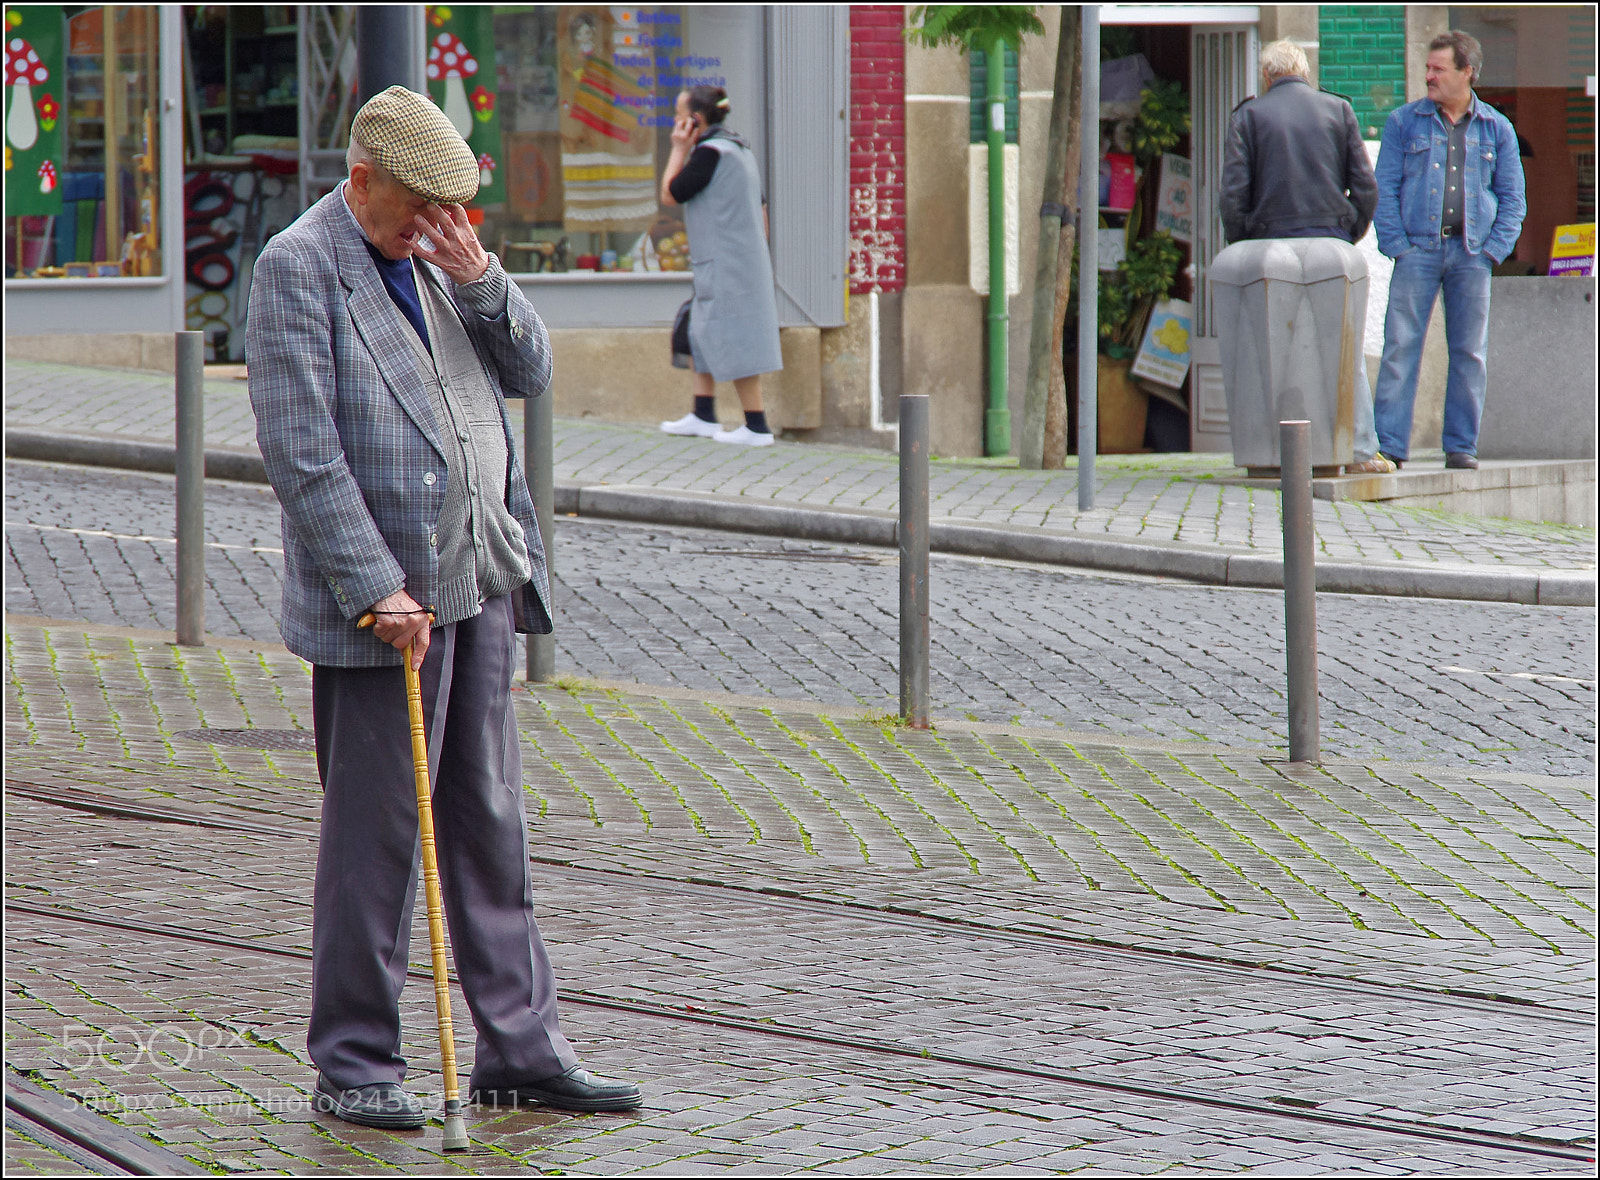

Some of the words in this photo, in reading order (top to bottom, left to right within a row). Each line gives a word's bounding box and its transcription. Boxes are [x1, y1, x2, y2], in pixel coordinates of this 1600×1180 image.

[613, 53, 651, 67] Todos
[656, 56, 671, 67] os
[675, 53, 721, 70] artigos
[637, 73, 654, 87] de
[638, 113, 675, 127] Costu
